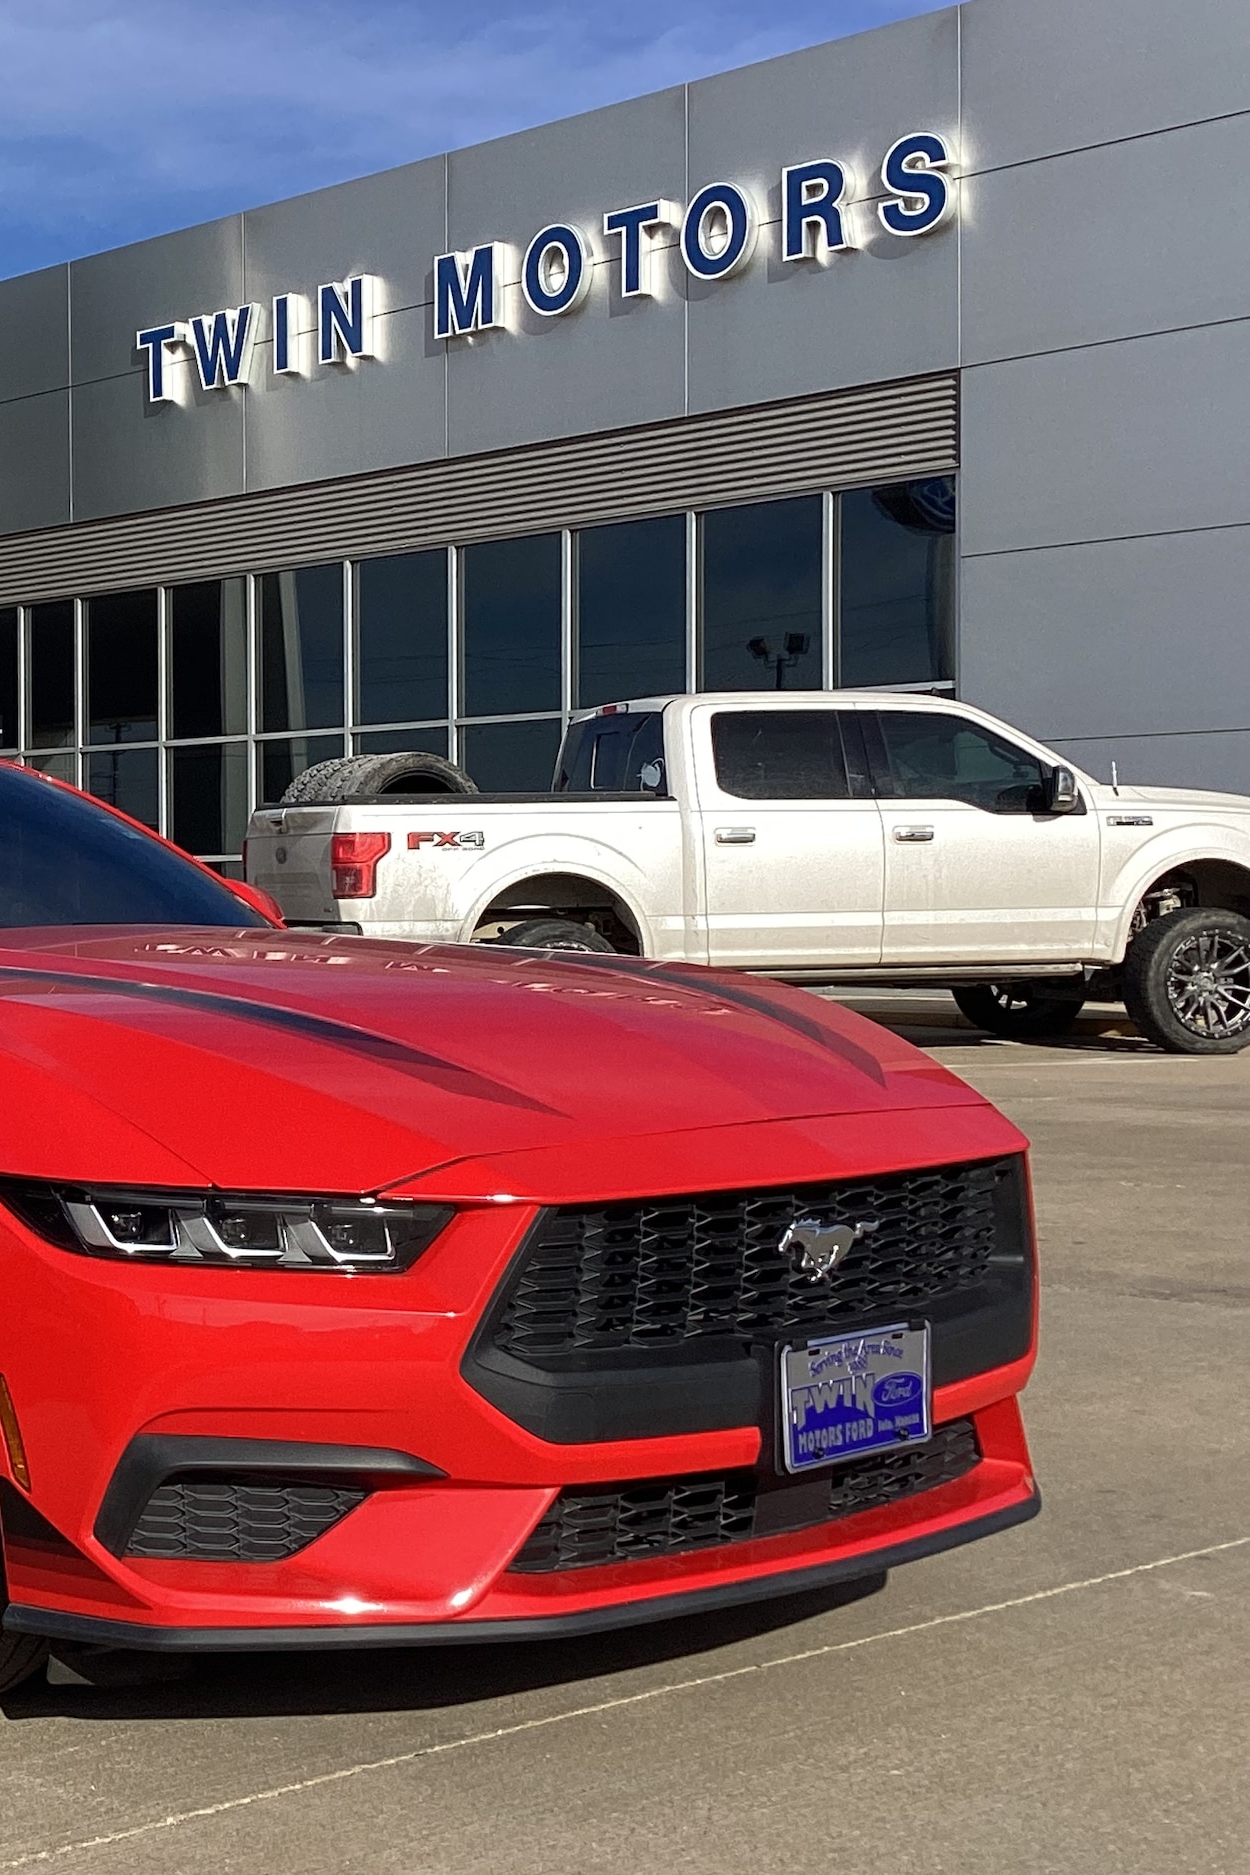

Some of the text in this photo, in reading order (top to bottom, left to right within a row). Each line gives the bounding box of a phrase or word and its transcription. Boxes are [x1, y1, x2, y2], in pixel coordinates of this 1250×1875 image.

[136, 131, 952, 402] TWIN MOTORS
[407, 831, 485, 850] FX4
[808, 1350, 843, 1378] Serving
[791, 1373, 876, 1431] TWIN
[881, 1377, 913, 1401] Ford
[798, 1418, 875, 1455] MOTORS FORD
